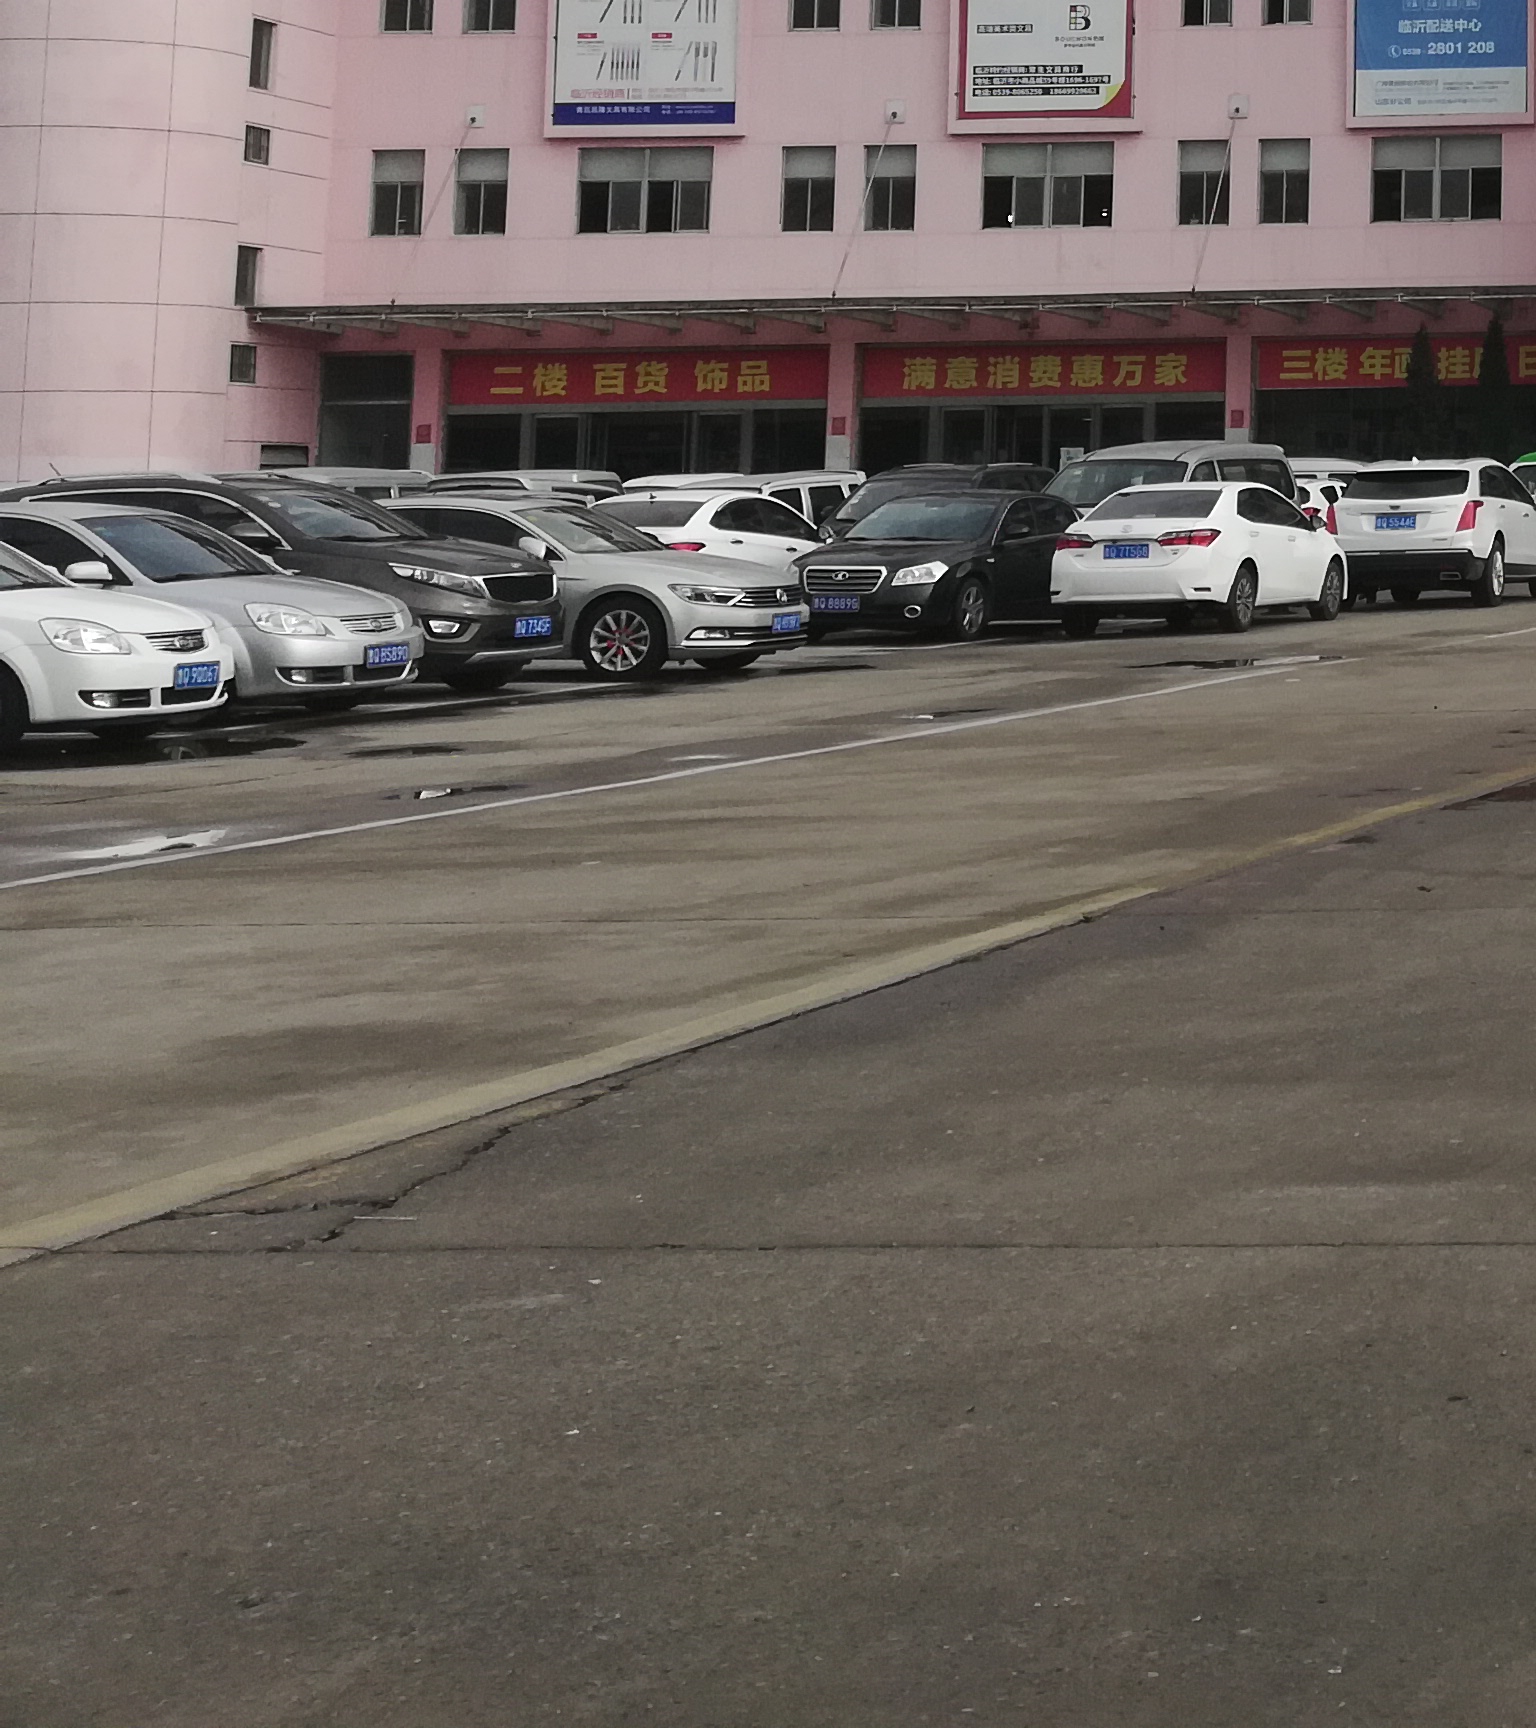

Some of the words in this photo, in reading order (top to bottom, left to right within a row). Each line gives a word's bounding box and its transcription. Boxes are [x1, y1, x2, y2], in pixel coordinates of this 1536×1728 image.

[1398, 18, 1482, 33] 临沂配送中心
[1427, 42, 1462, 54] 2801
[1467, 42, 1495, 54] 208
[490, 362, 567, 398] 二楼
[592, 361, 669, 396] 百货
[694, 359, 771, 393] 饰品
[902, 352, 1189, 392] 满意消费惠万家
[1280, 346, 1346, 381] 三楼
